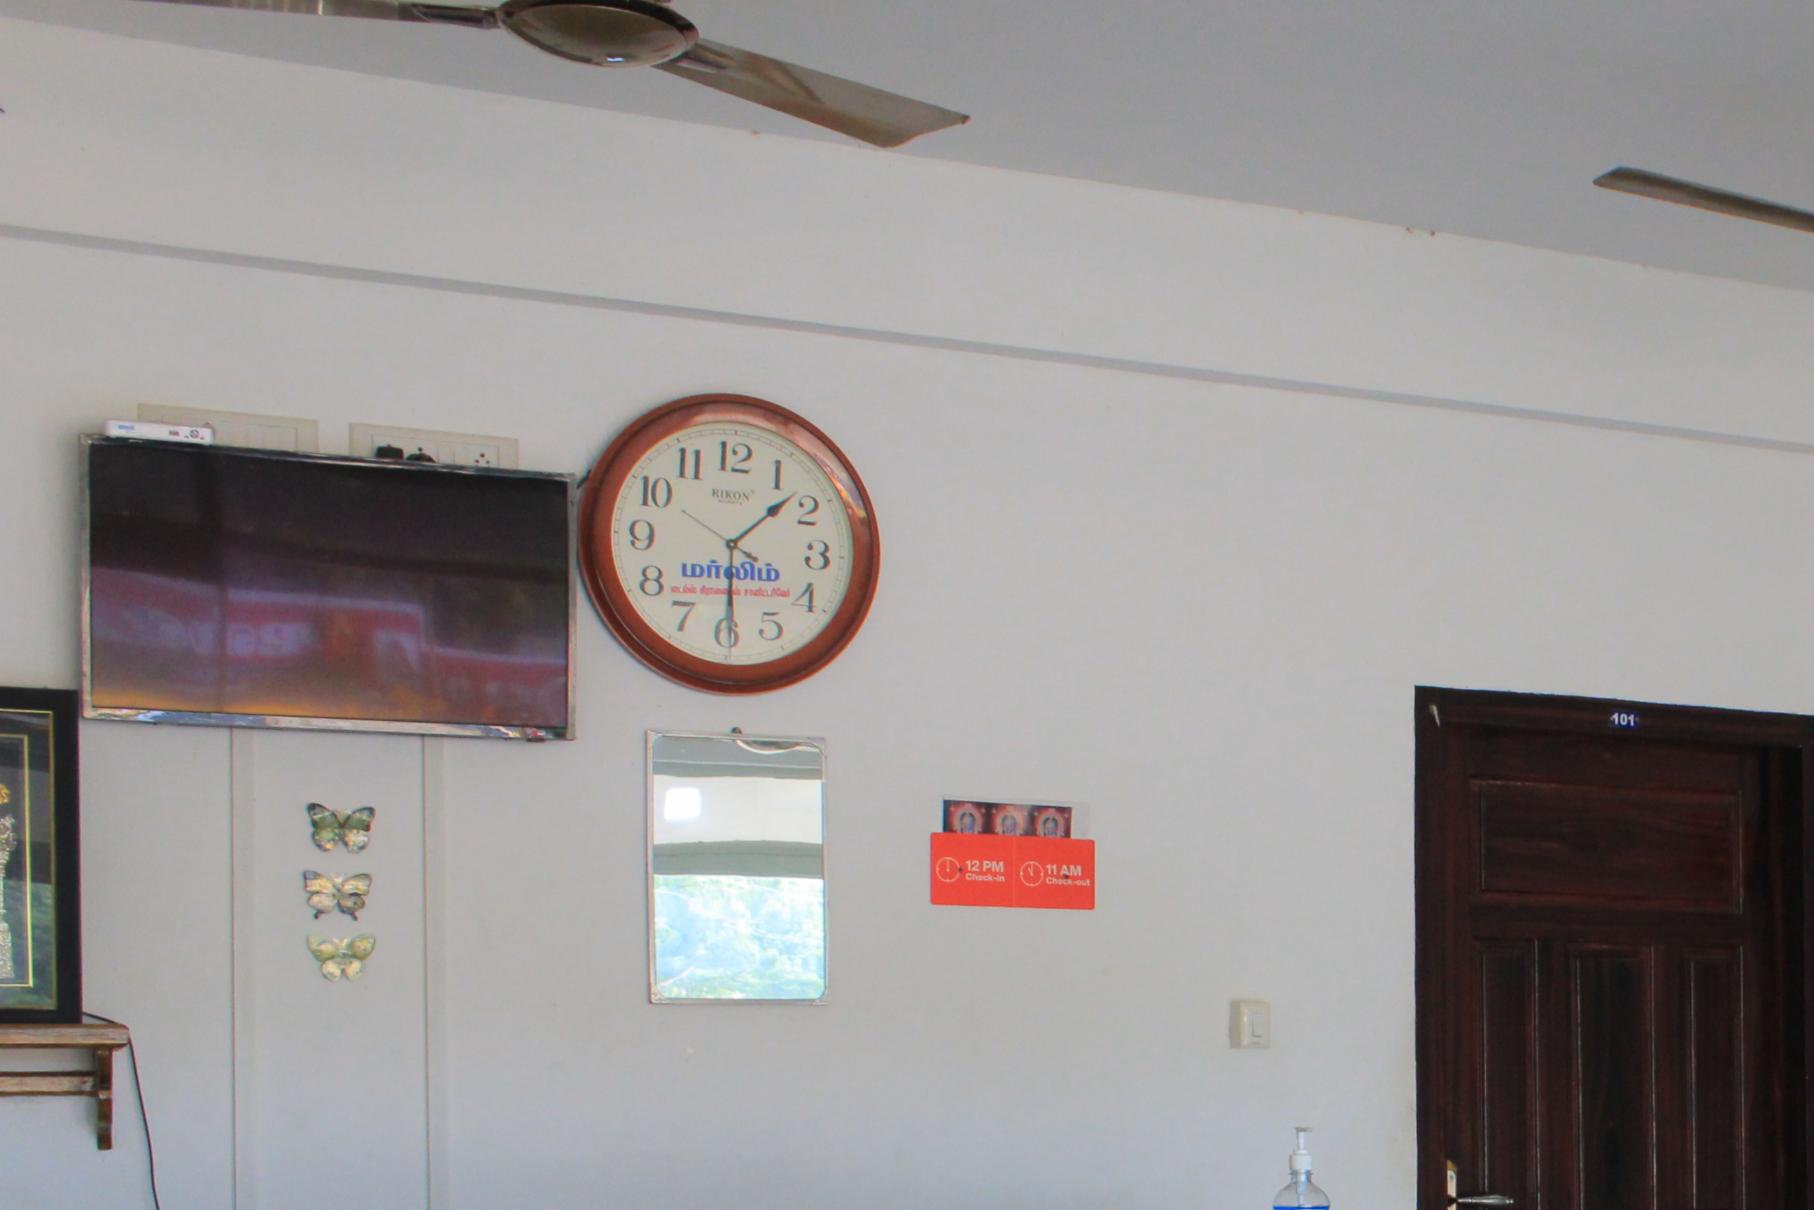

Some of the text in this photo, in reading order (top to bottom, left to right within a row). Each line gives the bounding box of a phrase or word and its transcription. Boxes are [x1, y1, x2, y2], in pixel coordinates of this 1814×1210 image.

[677, 447, 704, 480] 11
[718, 440, 753, 474] 12
[772, 459, 782, 490] 1
[640, 476, 672, 509] 10
[711, 488, 750, 502] RIKON
[797, 495, 819, 526] 2
[628, 519, 655, 551] 9
[804, 540, 831, 570] 3
[639, 565, 664, 596] 8
[791, 582, 817, 614] 4
[671, 601, 697, 632] 7
[758, 612, 784, 641] 5
[714, 617, 740, 648] 6
[1610, 712, 1635, 727] 101
[965, 860, 1004, 873] 12 PM
[965, 873, 1005, 882] Check-in
[1045, 877, 1090, 886] Check-out
[1046, 864, 1082, 877] 11 AM
